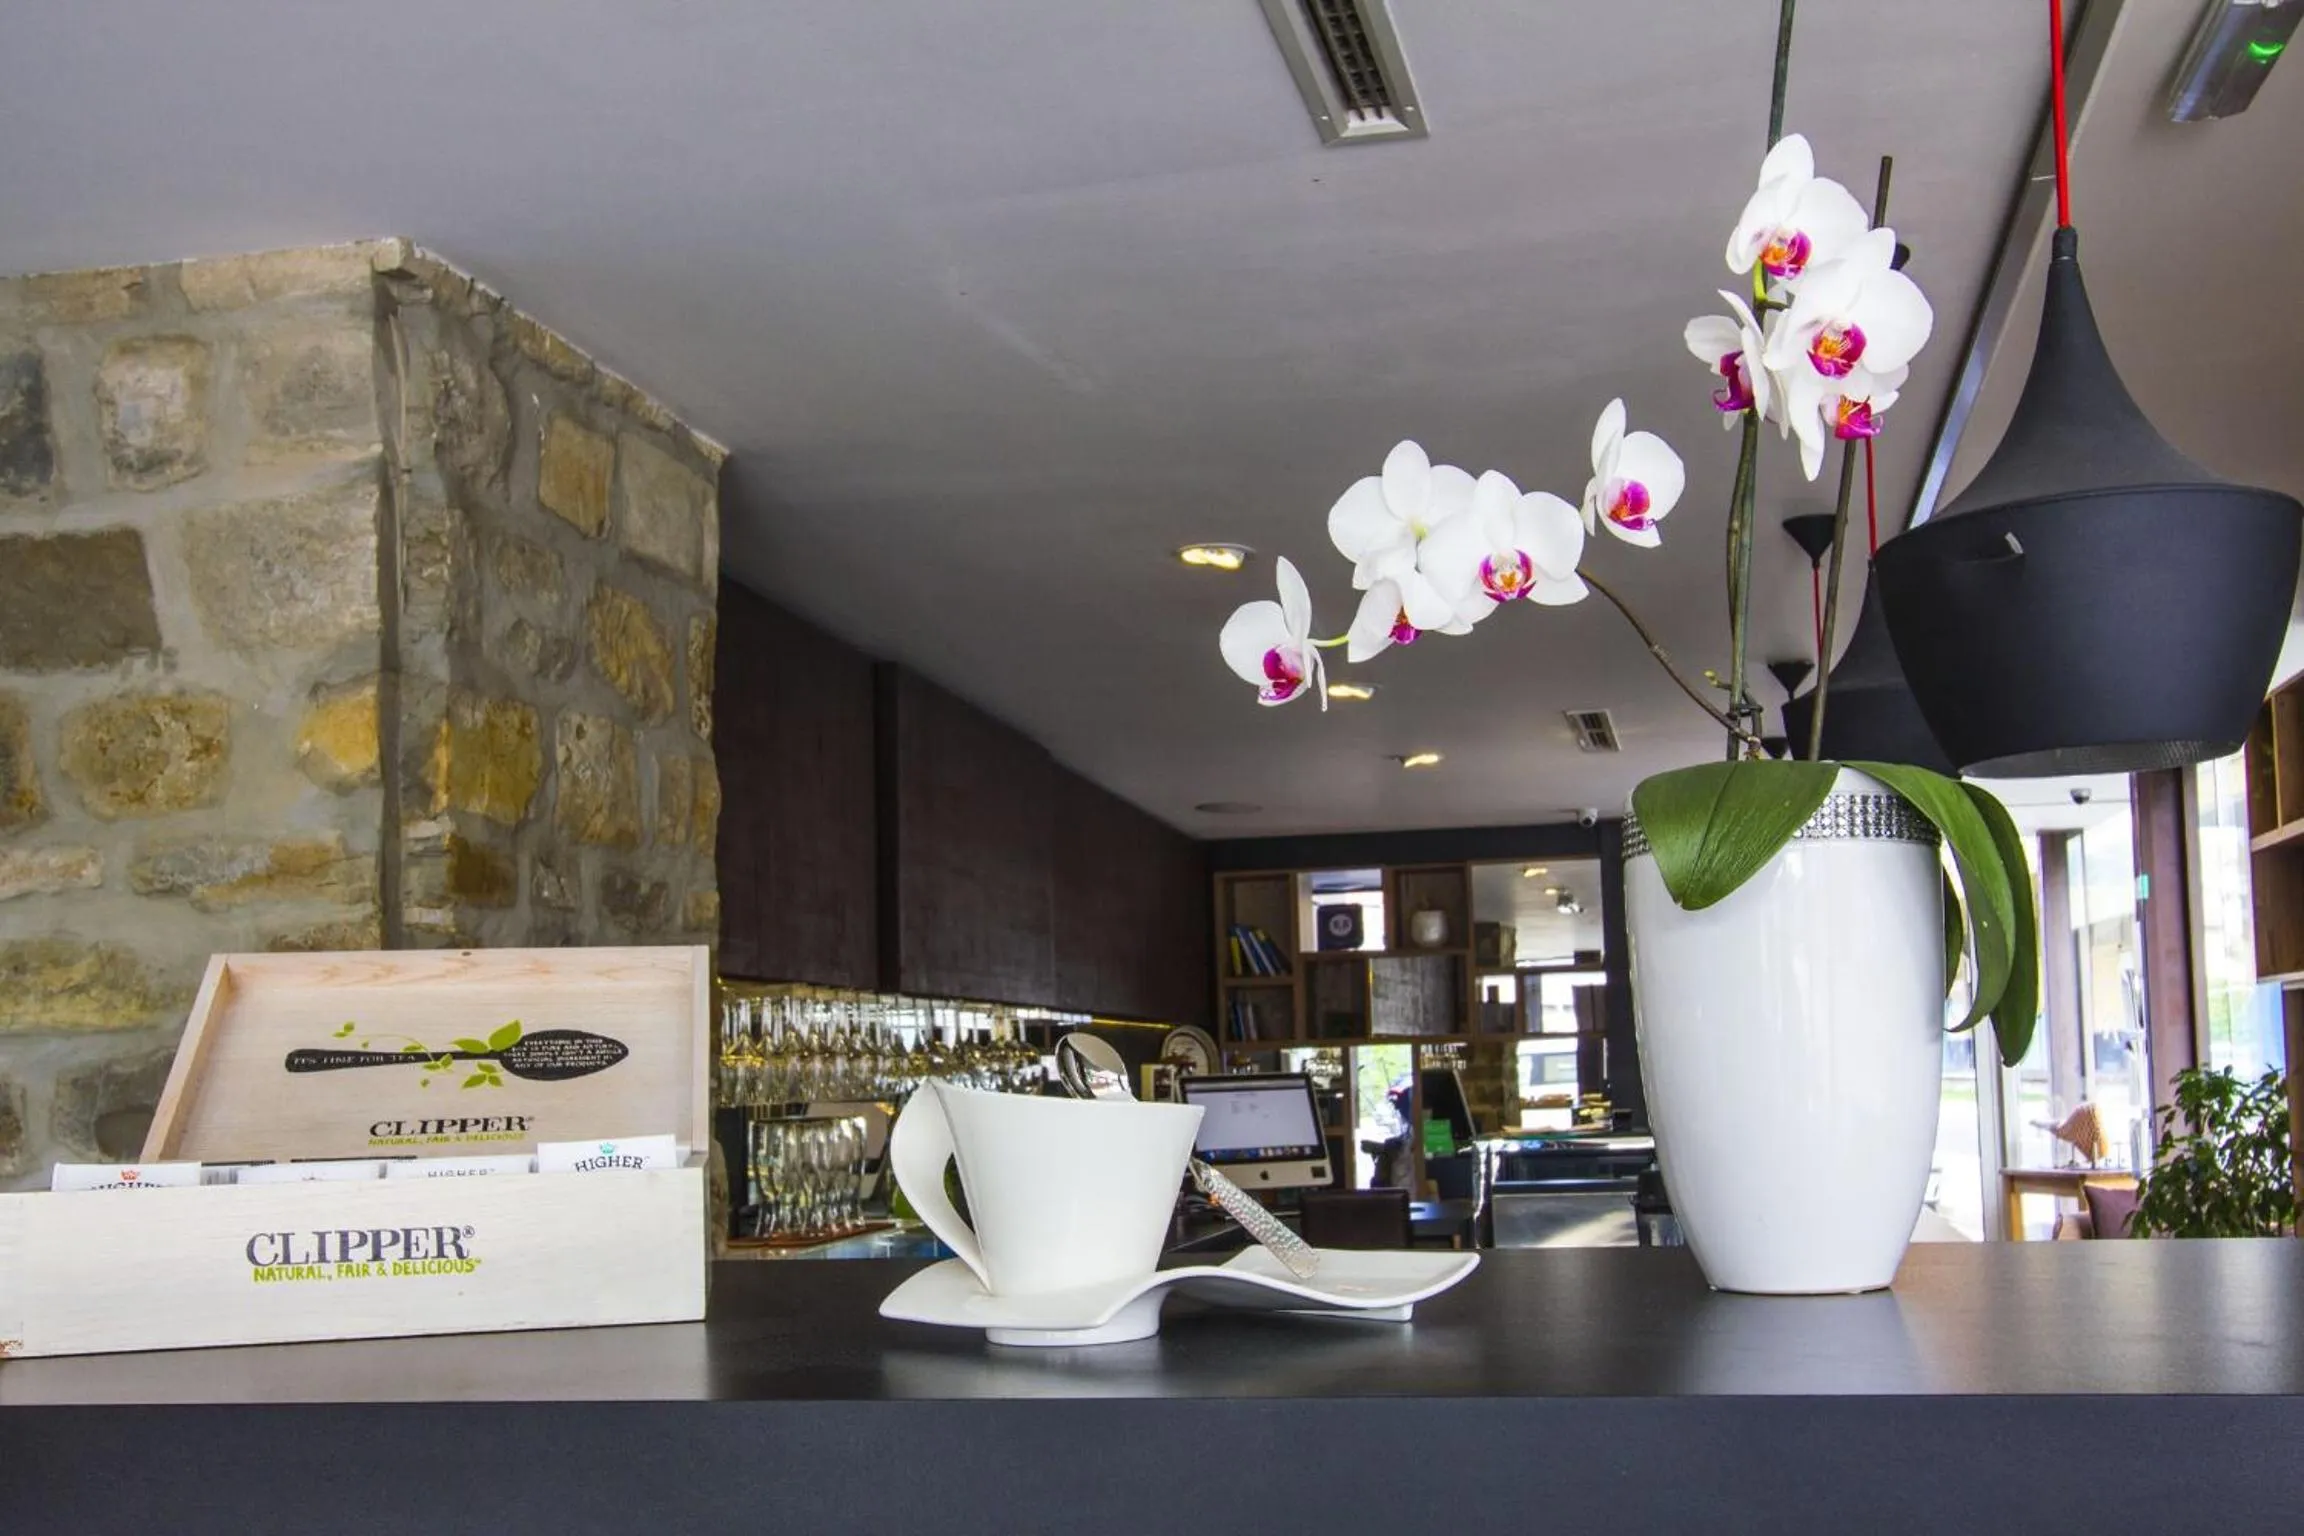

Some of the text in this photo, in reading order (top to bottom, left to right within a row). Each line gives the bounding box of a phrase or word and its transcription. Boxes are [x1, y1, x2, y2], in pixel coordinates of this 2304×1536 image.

[253, 1264, 333, 1283] NATURAL,
[337, 1262, 371, 1279] FAIR
[376, 1262, 387, 1277] &
